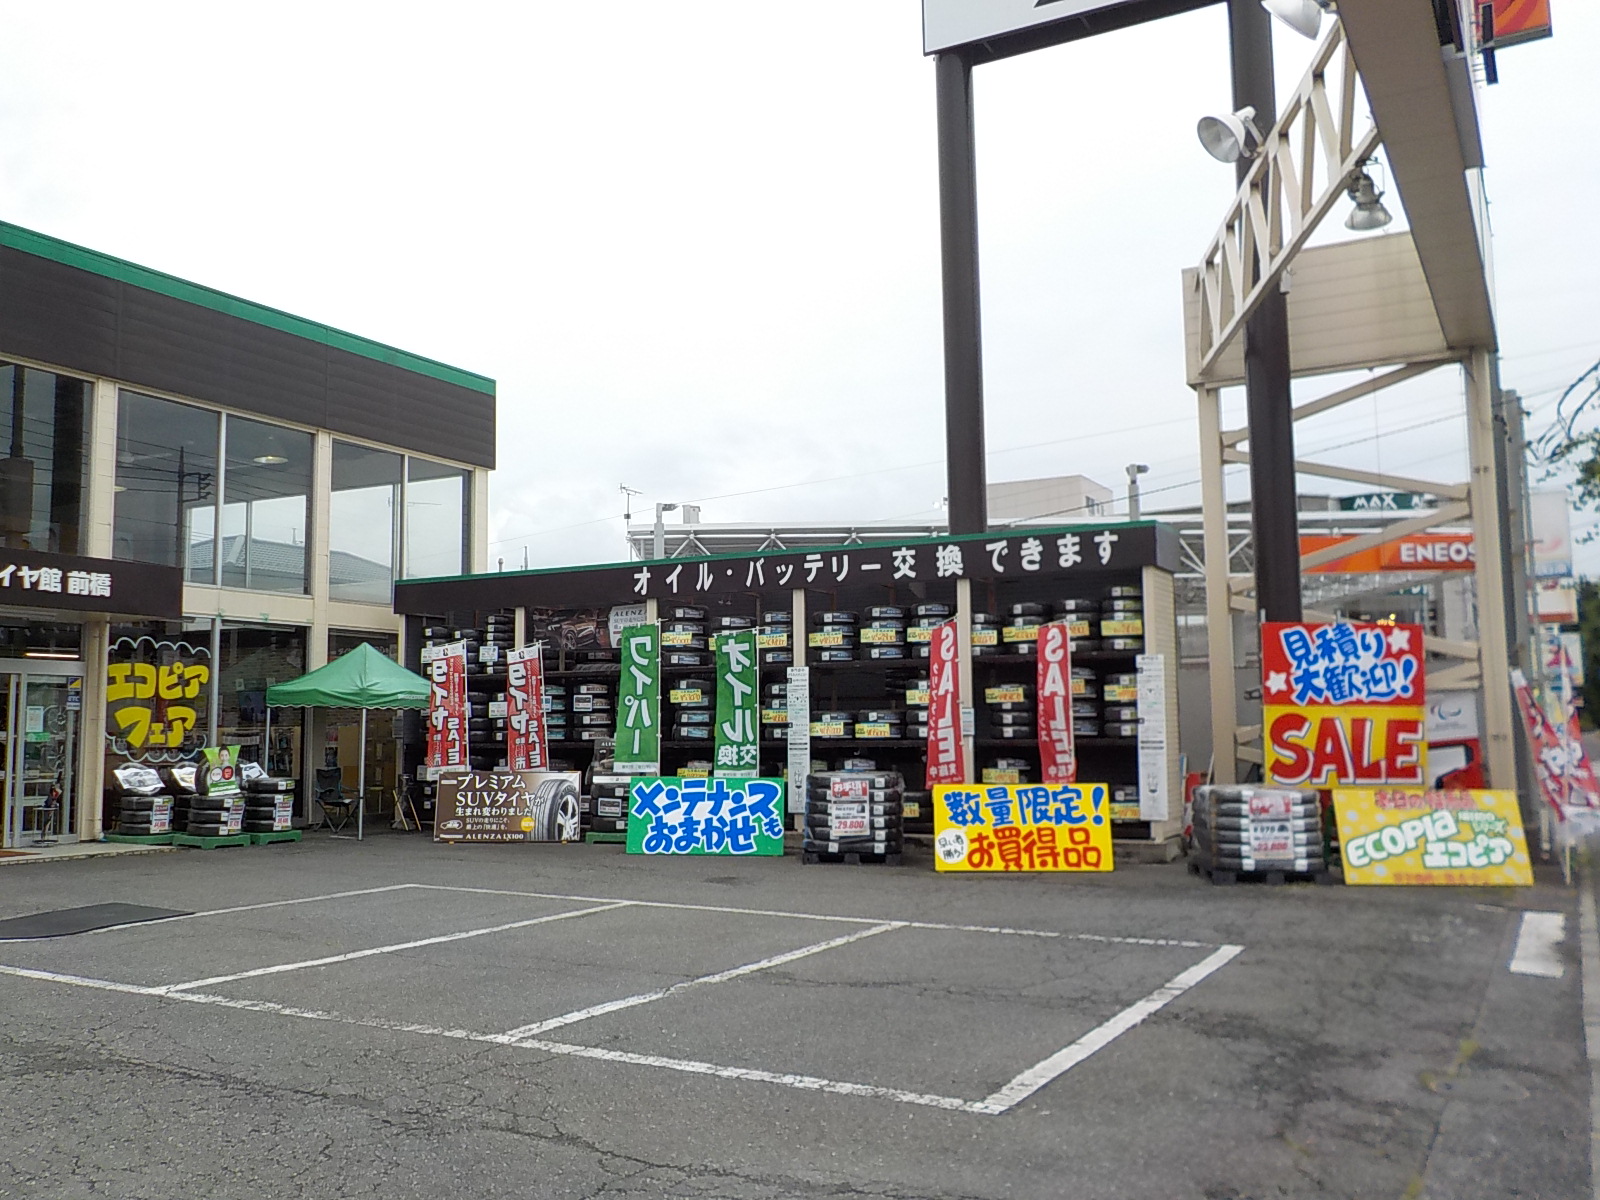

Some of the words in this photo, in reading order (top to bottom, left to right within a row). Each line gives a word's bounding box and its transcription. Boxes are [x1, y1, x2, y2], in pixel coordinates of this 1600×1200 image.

[1353, 494, 1398, 510] MAX
[67, 570, 112, 598] 前橋
[613, 609, 648, 618] ALENZ
[1281, 623, 1386, 671] 見積り
[106, 661, 210, 702] エコピア
[1293, 658, 1415, 704] 大歓迎!
[114, 705, 197, 749] フェア
[1269, 713, 1425, 786] SALE
[455, 791, 545, 807] SUVタイヤが
[455, 806, 532, 817] 生まれ変わりました
[632, 779, 780, 819] メンテナンス
[943, 785, 1105, 827] 数量限定!
[967, 826, 1103, 871] お買得品
[1424, 835, 1514, 869] エコピア
